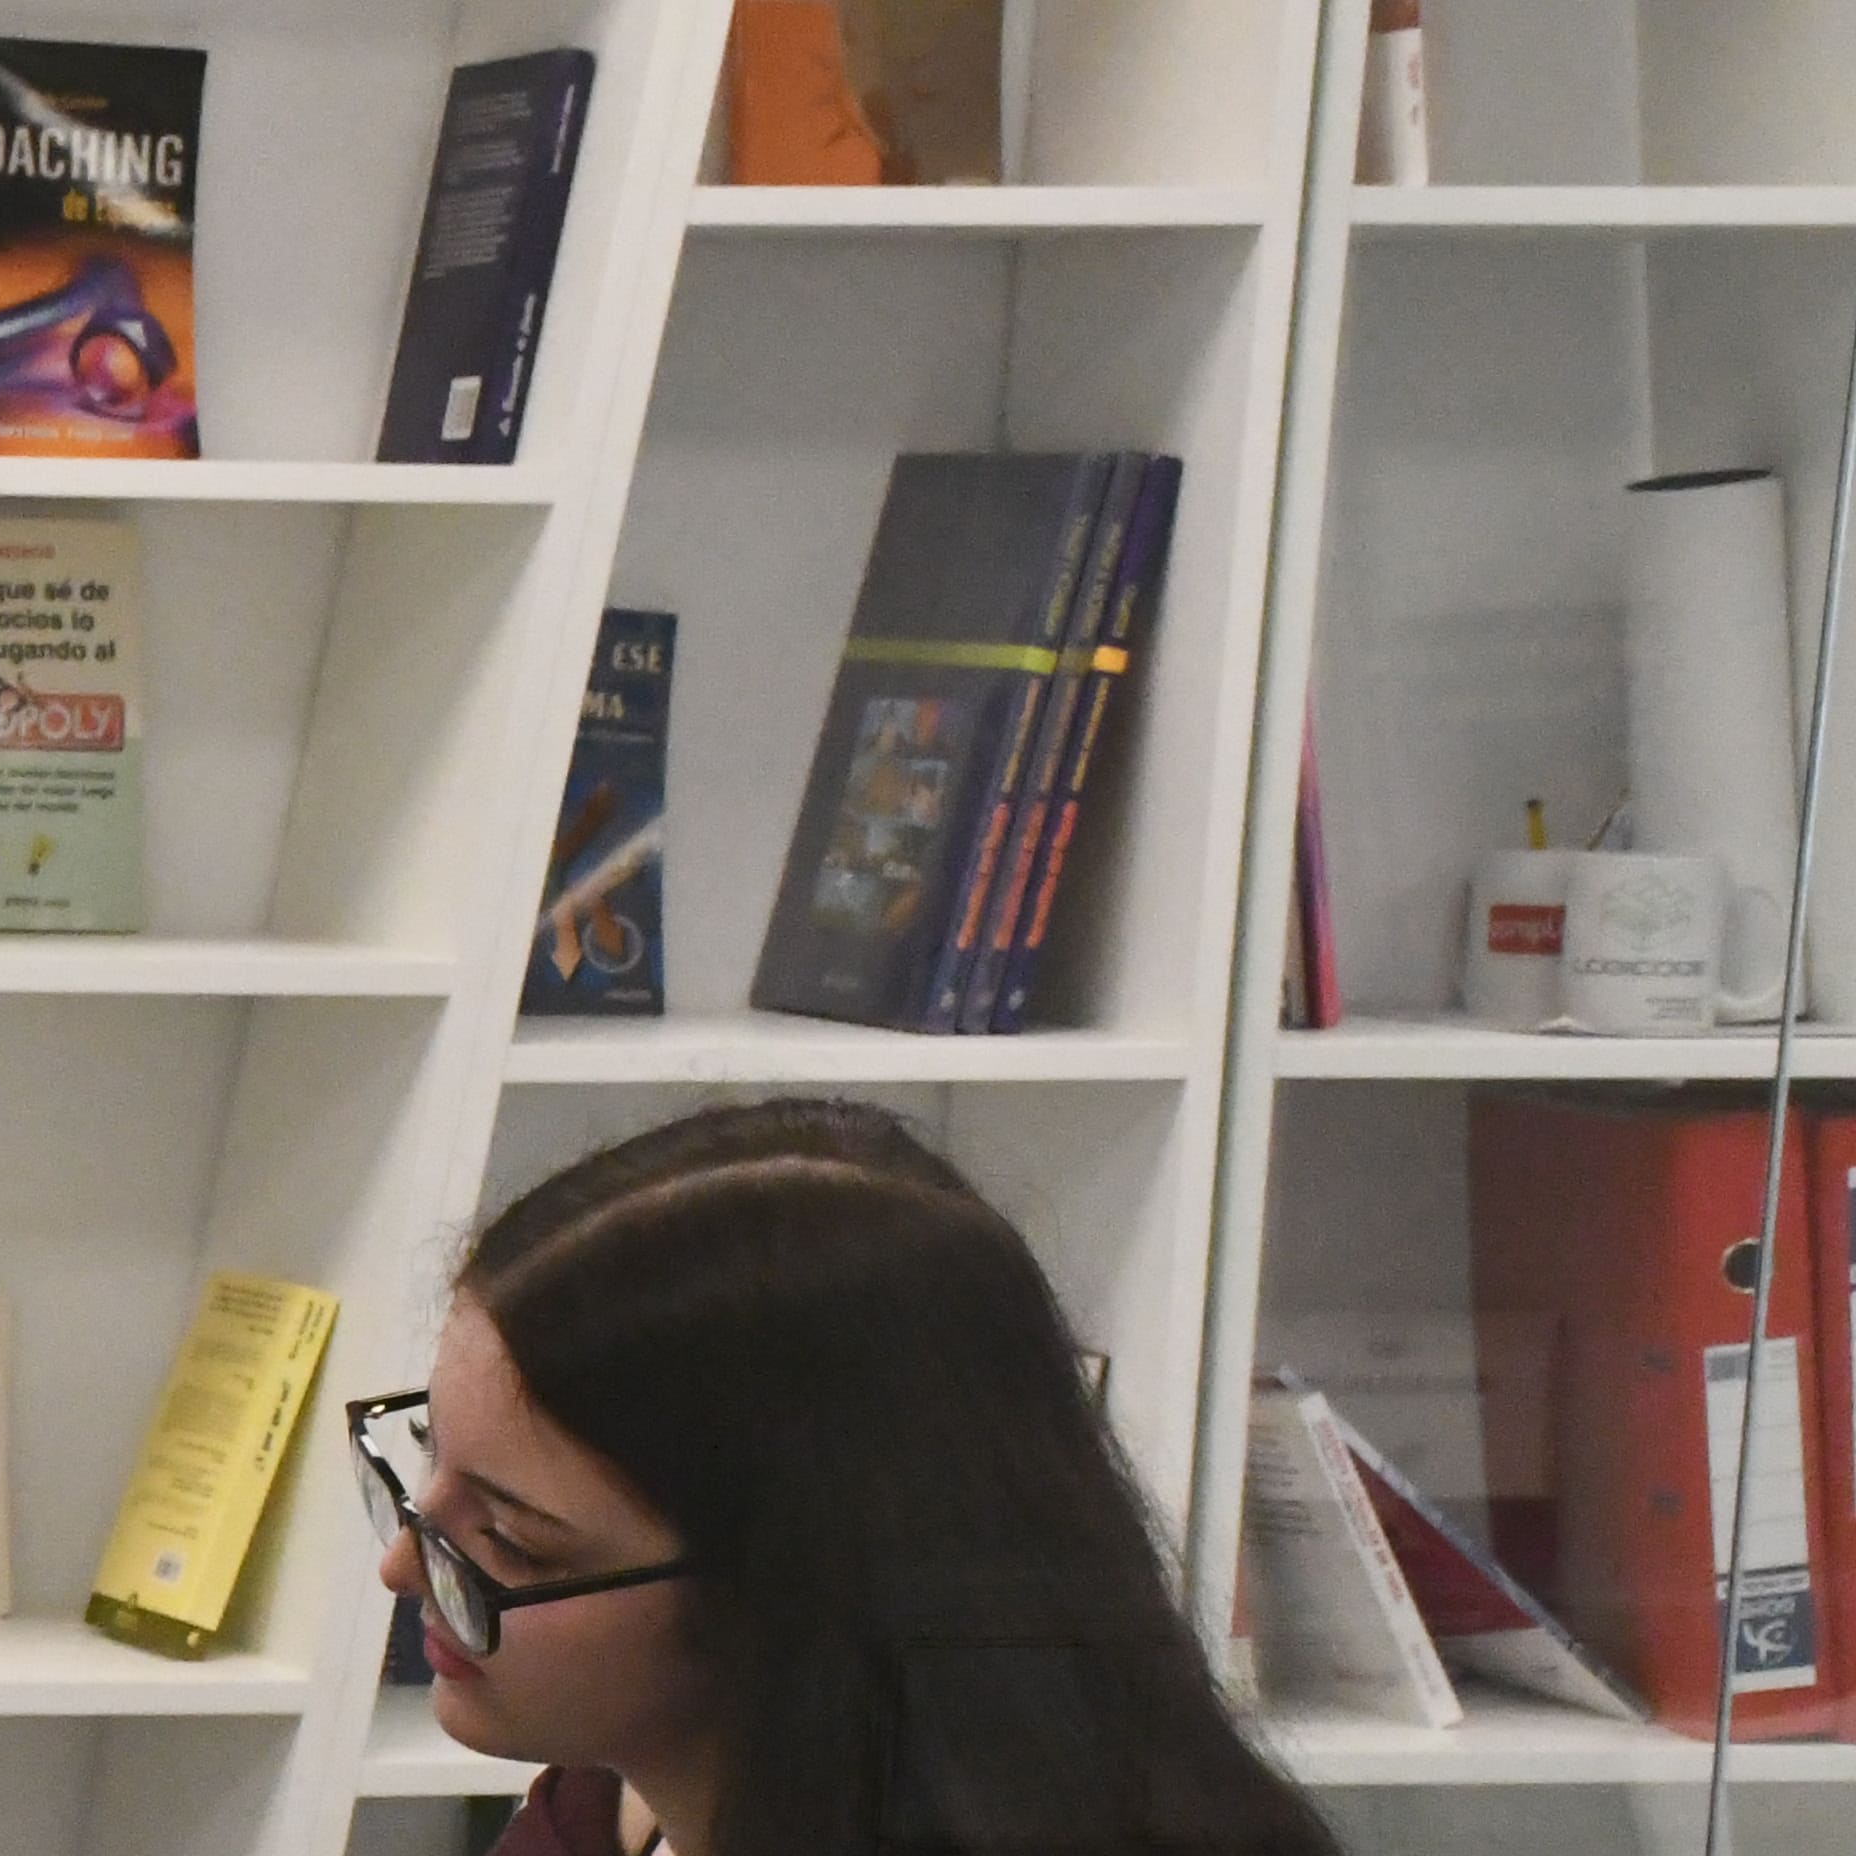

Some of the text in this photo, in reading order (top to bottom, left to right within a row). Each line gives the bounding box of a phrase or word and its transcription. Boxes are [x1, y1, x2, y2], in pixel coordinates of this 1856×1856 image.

[80, 578, 110, 601] de
[71, 608, 96, 632] lo
[94, 639, 117, 661] al
